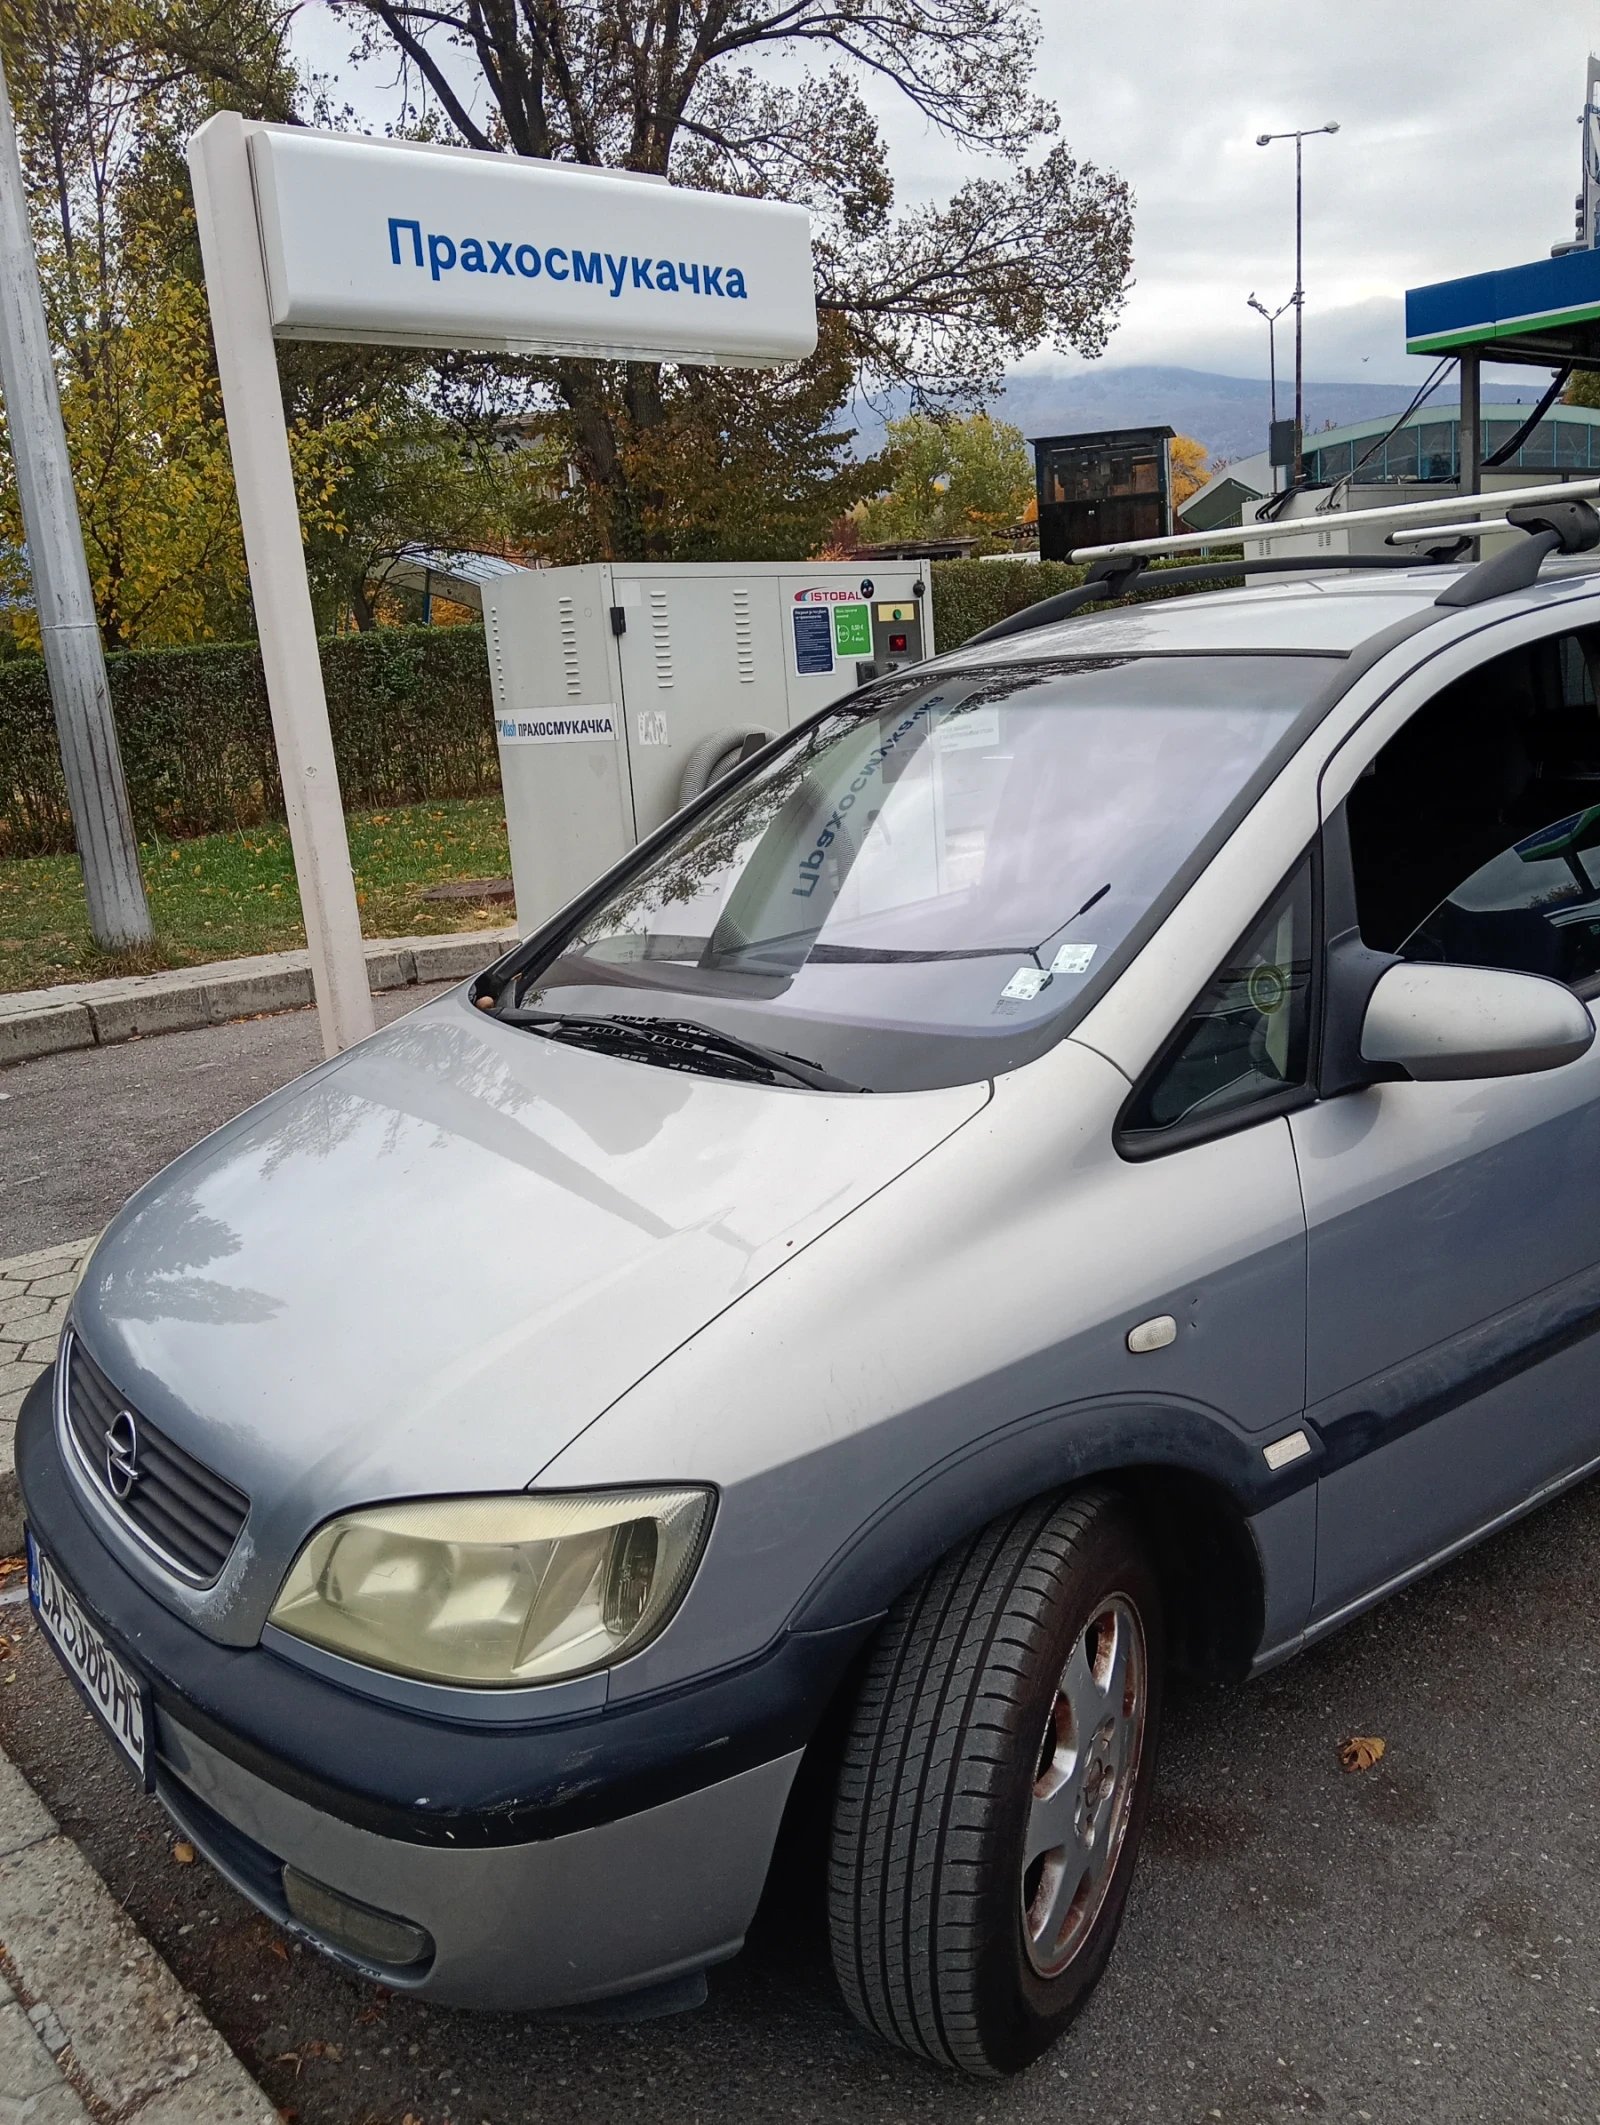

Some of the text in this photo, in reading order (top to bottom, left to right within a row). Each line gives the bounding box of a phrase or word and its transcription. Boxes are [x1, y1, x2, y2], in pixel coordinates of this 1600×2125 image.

[387, 217, 748, 299] Прахосмукачка
[811, 592, 862, 601] ISTOBAL
[518, 718, 613, 737] ПРАХОСМУКАЧКА
